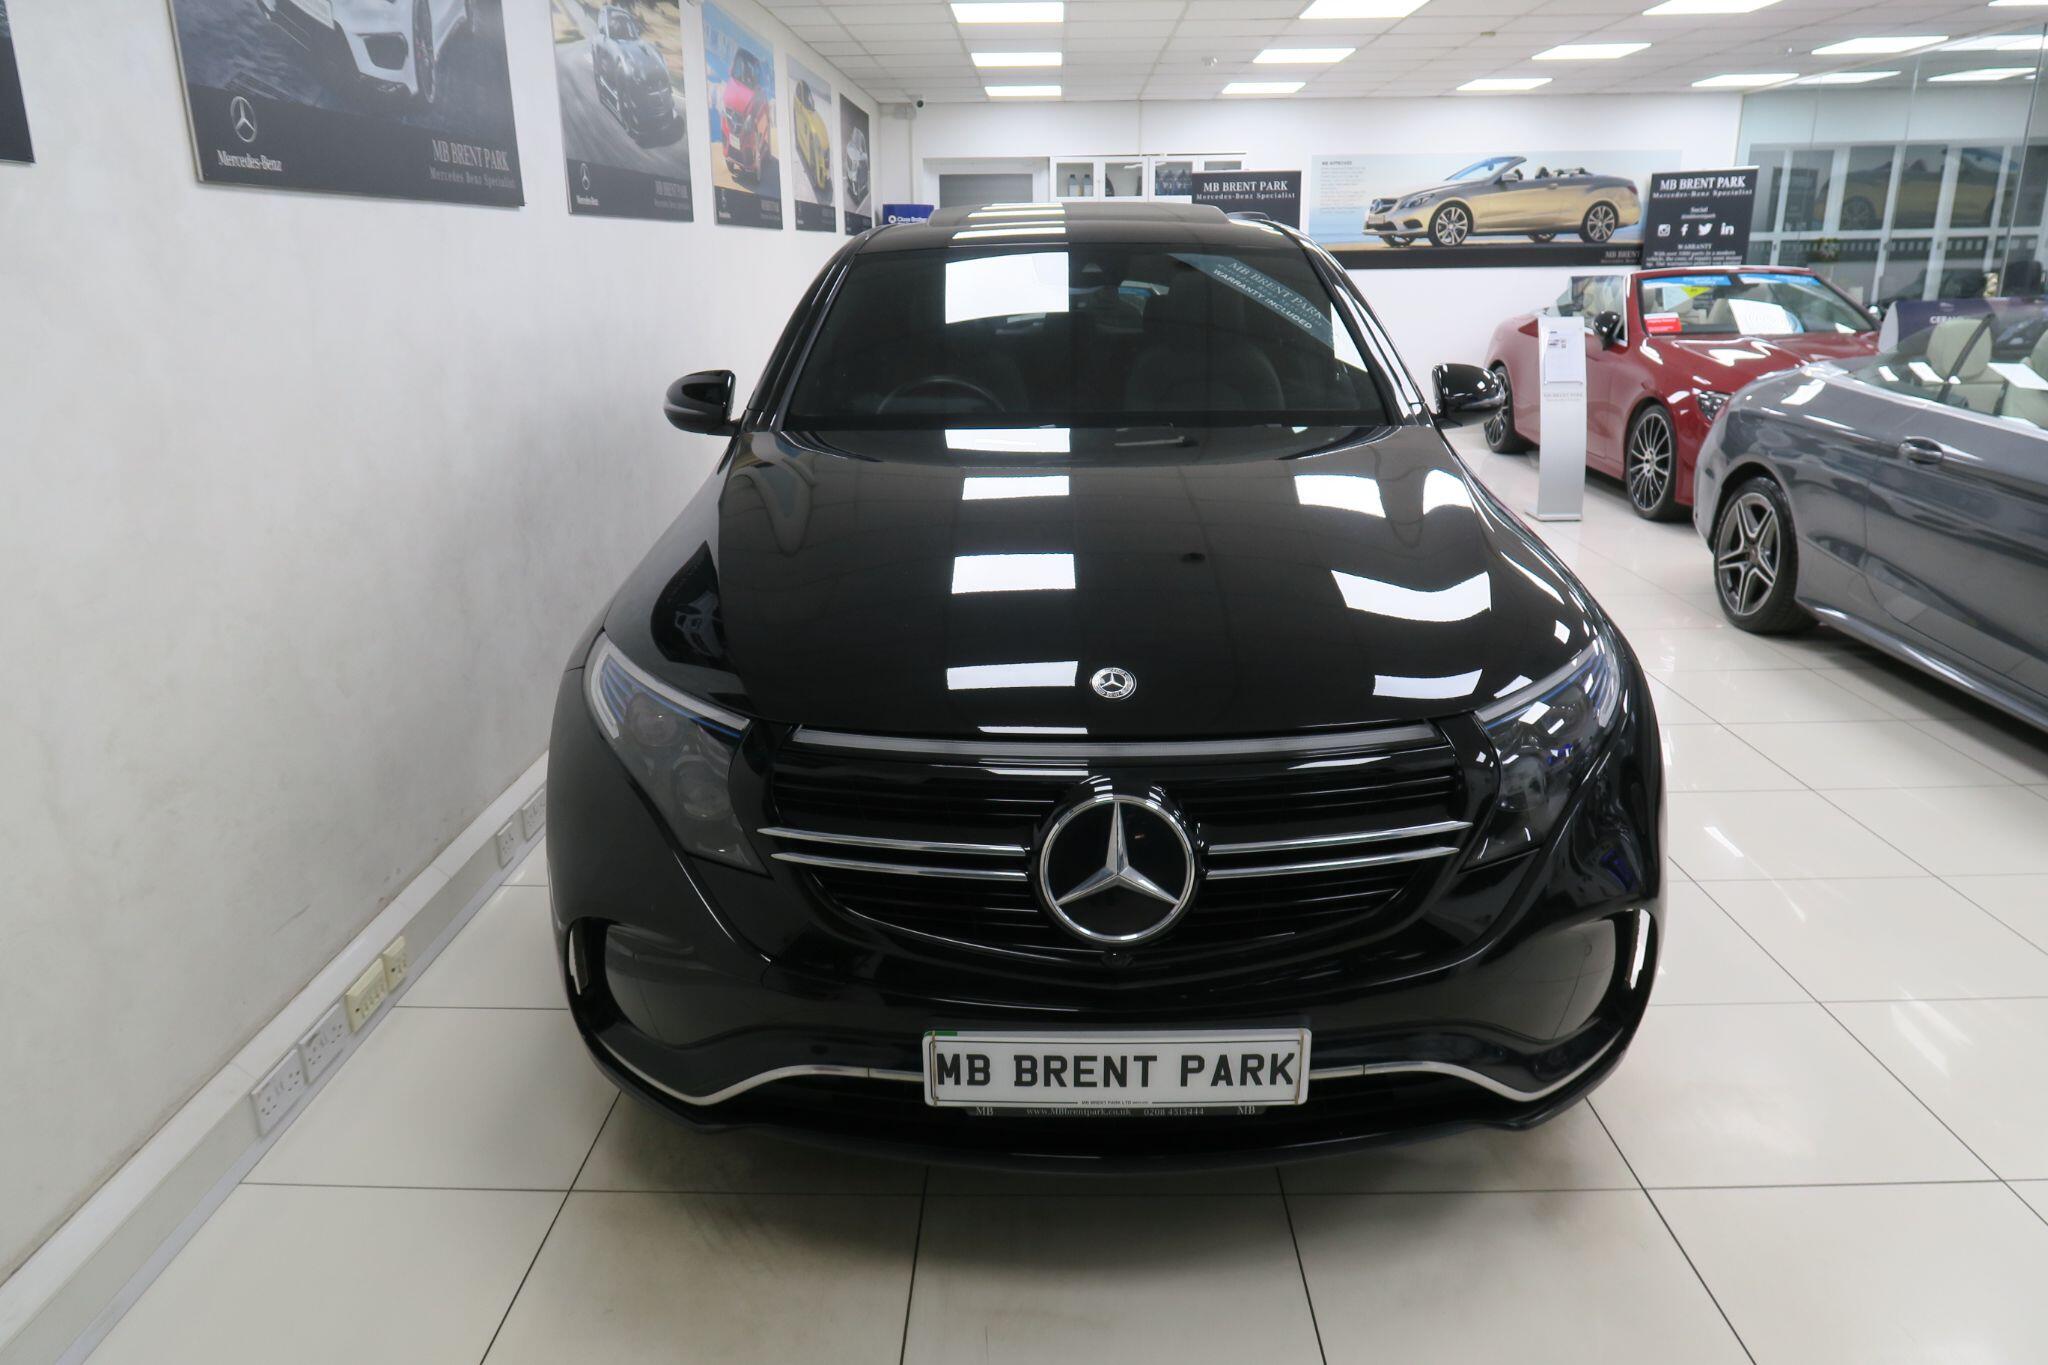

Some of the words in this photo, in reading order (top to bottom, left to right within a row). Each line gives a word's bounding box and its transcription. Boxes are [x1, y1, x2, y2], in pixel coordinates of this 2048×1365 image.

[432, 139, 449, 162] MB
[450, 142, 482, 167] BRENT
[483, 148, 510, 171] PARK
[1203, 182, 1219, 192] MB
[1222, 181, 1257, 191] BRENT
[1260, 181, 1288, 191] PARK
[1660, 179, 1677, 190] MB
[1679, 178, 1716, 189] BRENT
[1717, 176, 1746, 188] PARK
[1256, 192, 1295, 200] Specialist
[1713, 189, 1752, 197] Specialist
[1230, 262, 1249, 275] MB
[1250, 272, 1293, 298] BRENT
[1291, 296, 1322, 319] PARK
[1213, 268, 1265, 299] WARRANTY
[1264, 298, 1313, 329] INCLUDED
[937, 1053, 990, 1086] MB
[1014, 1055, 1157, 1088] BRENT
[1180, 1053, 1295, 1087] PARK
[976, 1106, 994, 1116] MB
[1143, 1107, 1166, 1117] 0208
[1237, 1105, 1256, 1115] MB
